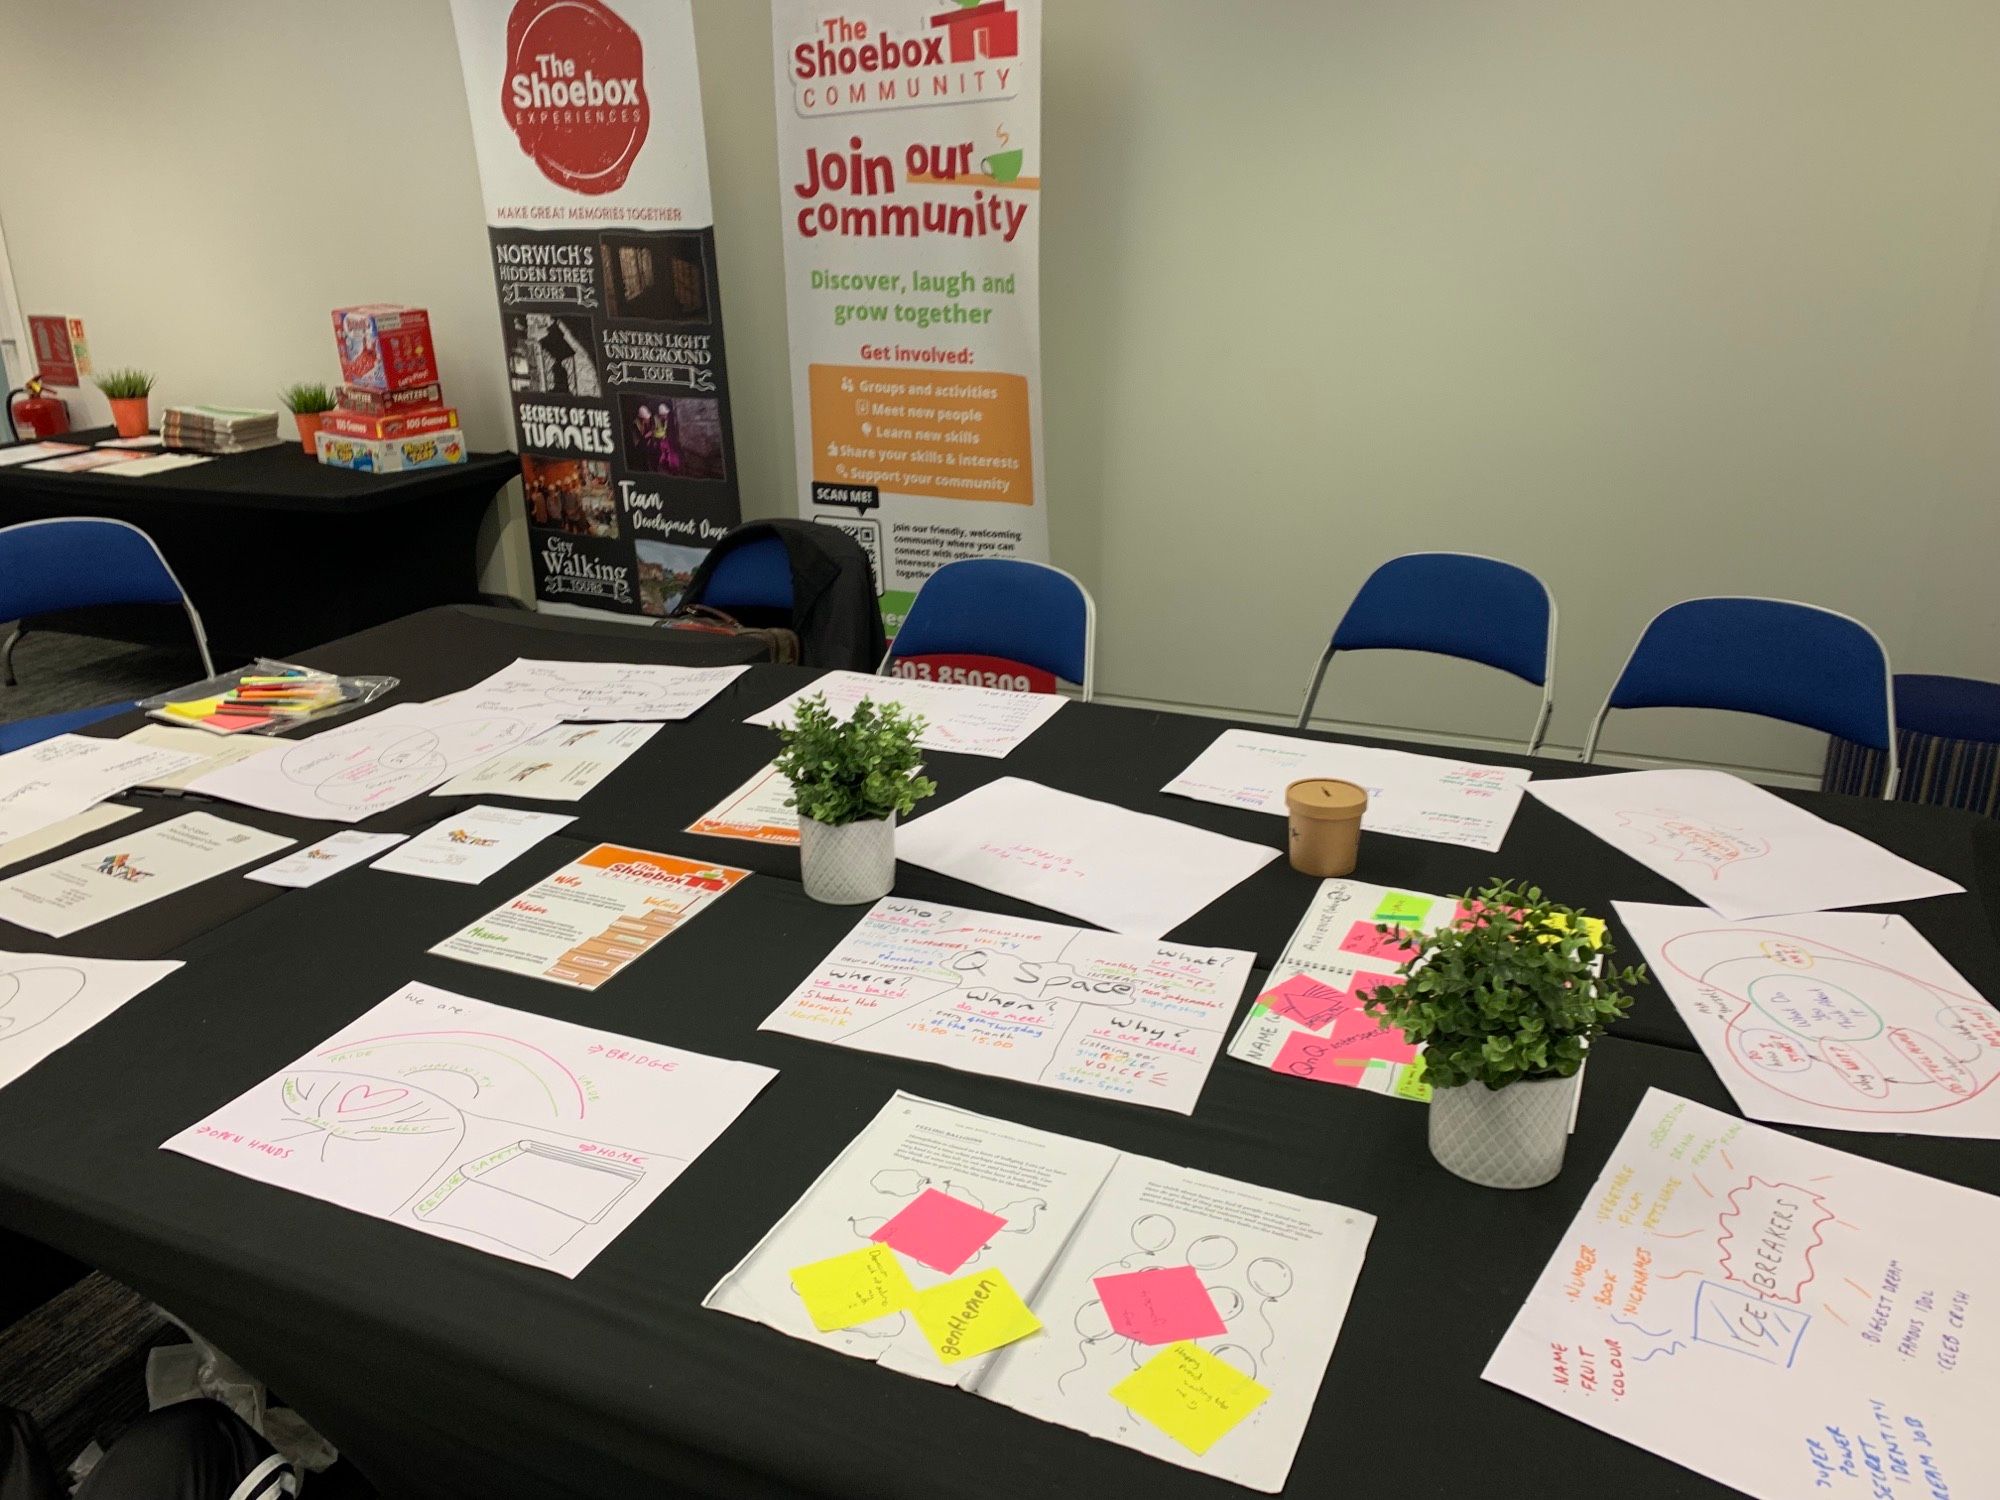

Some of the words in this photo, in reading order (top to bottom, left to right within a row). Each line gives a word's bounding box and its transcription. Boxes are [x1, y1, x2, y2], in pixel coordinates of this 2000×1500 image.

[823, 16, 867, 44] The
[536, 53, 575, 79] The
[795, 31, 944, 79] Shoebox
[511, 70, 640, 109] Shoebox
[803, 68, 1010, 108] COMMUNITY
[515, 109, 641, 125] EXPERIENCES
[794, 136, 895, 199] Join
[905, 141, 974, 180] our
[497, 206, 528, 220] MAKE
[530, 206, 565, 220] GREAT
[568, 206, 624, 221] MEMORIES
[626, 207, 682, 221] TOGETHER
[798, 190, 1028, 243] community
[496, 244, 594, 266] NORWICH'S
[499, 266, 546, 282] HIDDEN
[549, 267, 595, 283] STREET
[811, 270, 906, 294] Discover,
[912, 270, 975, 297] laugh
[982, 273, 1015, 294] and
[527, 286, 565, 299] TOURS
[834, 303, 888, 326] grow
[895, 303, 993, 328] together
[603, 330, 664, 348] LANTERN
[666, 334, 711, 349] LIGHT
[605, 347, 711, 365] UNDERGROUND
[860, 344, 890, 361] Get
[895, 345, 975, 365] involved:
[642, 367, 674, 381] TOUR
[859, 380, 905, 396] Groups
[908, 382, 932, 396] and
[935, 382, 998, 400] activities
[406, 418, 420, 429] 100
[421, 415, 448, 428] Games
[520, 403, 568, 425] SECRETS
[569, 407, 585, 426] OF
[585, 408, 610, 428] THE
[872, 403, 904, 417] Meet
[907, 406, 935, 418] new
[937, 407, 983, 424] people
[522, 423, 615, 454] TUNNELS
[876, 426, 912, 440] Learn
[915, 428, 941, 441] new
[944, 429, 980, 445] skills
[840, 444, 876, 458] Share
[879, 448, 908, 463] your
[910, 448, 943, 464] skills
[946, 452, 956, 465] &
[959, 452, 1019, 470] interests
[850, 467, 901, 484] Support
[903, 471, 933, 487] your
[935, 473, 1011, 493] community
[618, 480, 663, 513] Team
[816, 487, 848, 501] SCAN
[850, 489, 873, 504] ME!
[633, 510, 696, 538] Development
[912, 525, 928, 533] our
[969, 529, 1022, 541] welcoming
[547, 536, 573, 556] City
[894, 535, 945, 547] community
[947, 539, 975, 549] where
[977, 542, 995, 551] you
[997, 543, 1015, 551] can
[895, 547, 931, 557] connect
[932, 549, 952, 558] with
[541, 551, 628, 581] Walking
[895, 558, 935, 568] interests
[938, 665, 1030, 693] 850309
[609, 863, 684, 885] Shoebox
[634, 863, 654, 873] The
[511, 900, 549, 916] Vision
[952, 950, 988, 977] Q
[1014, 961, 1133, 998] Space
[1247, 1025, 1278, 1060] NAME
[605, 1049, 679, 1072] BRIDGE
[1085, 1059, 1142, 1079] VOICE
[207, 1126, 244, 1151] OPEN
[247, 1137, 294, 1160] HANDS
[596, 1146, 650, 1165] HOME
[1566, 1245, 1596, 1298] NUMBER
[1624, 1247, 1651, 1315] NICKNAMES
[1594, 1270, 1617, 1306] BOOK
[1951, 1289, 1972, 1329] CRUSH
[1897, 1316, 1925, 1360] FAMOUS
[1551, 1343, 1569, 1386] NAME
[1579, 1346, 1597, 1392] FRUIT
[1605, 1339, 1625, 1396] COLOUR
[1826, 1426, 1858, 1477] POWER
